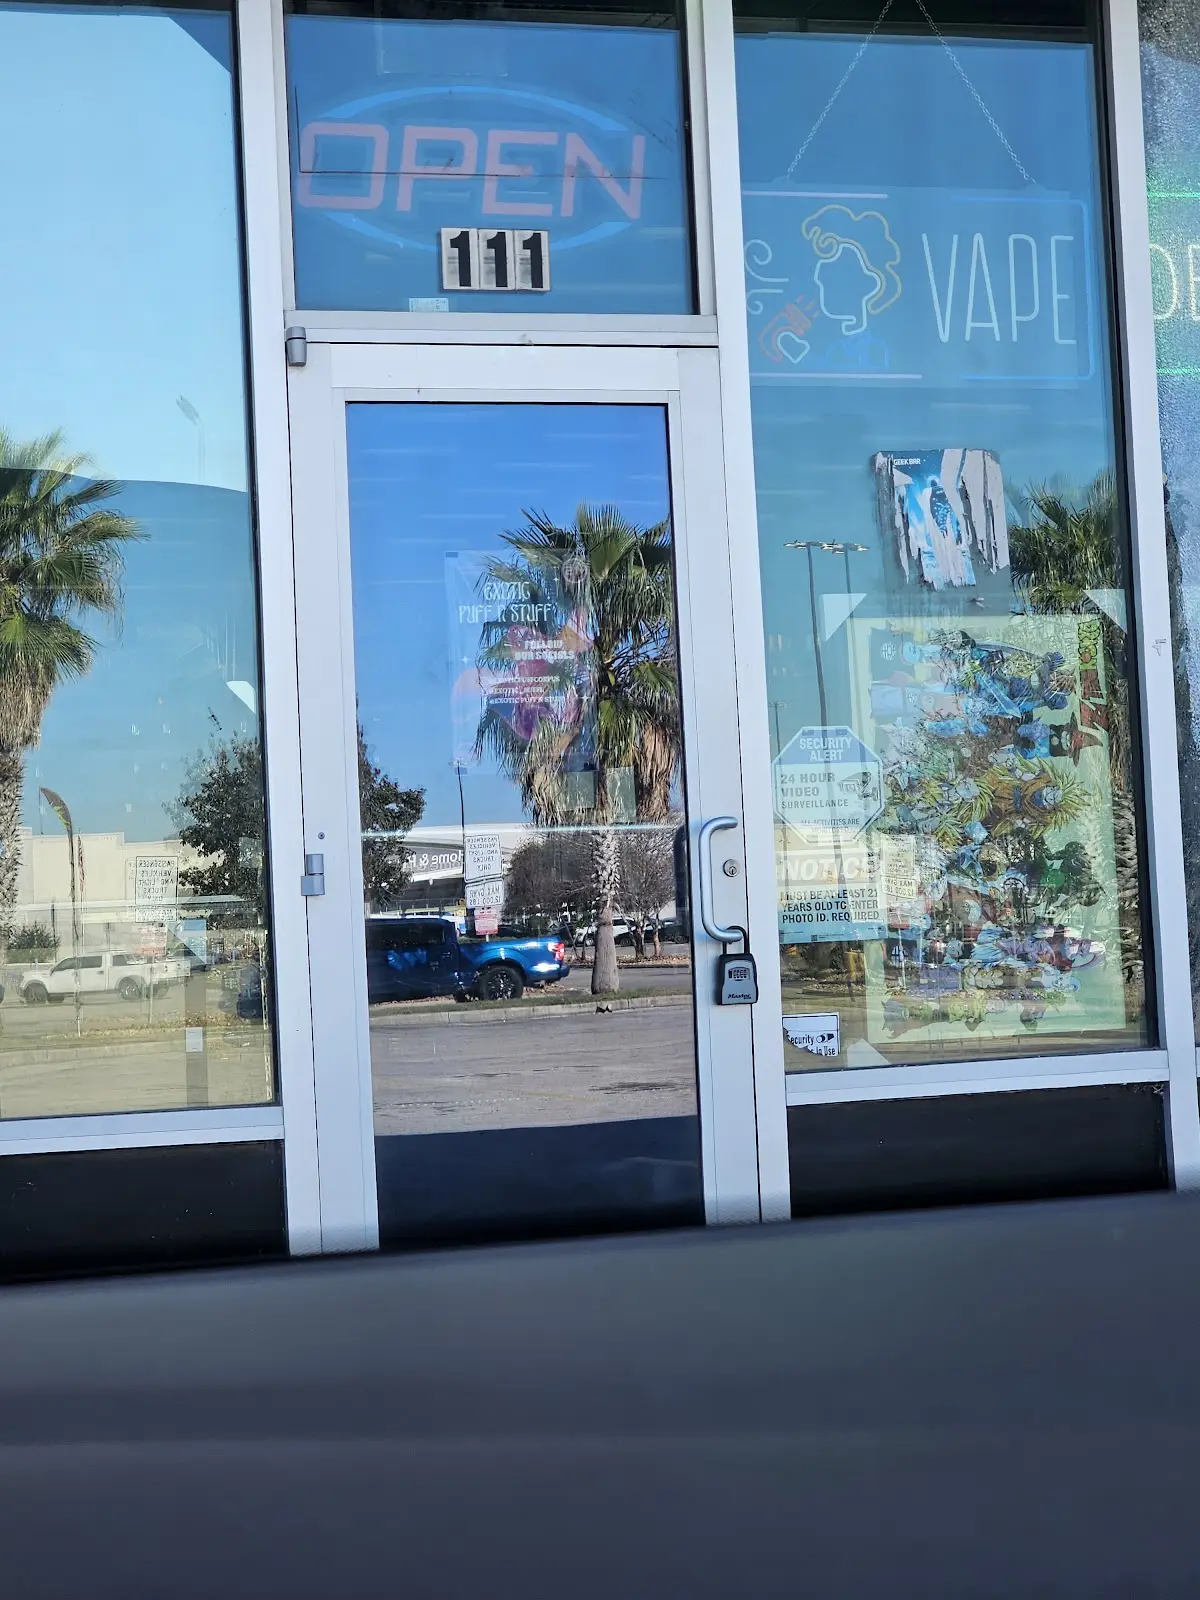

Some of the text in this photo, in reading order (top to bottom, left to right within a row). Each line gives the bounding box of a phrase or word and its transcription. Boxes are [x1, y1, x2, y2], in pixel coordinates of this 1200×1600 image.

[297, 121, 645, 219] OPEN
[449, 229, 544, 289] 111
[921, 232, 1077, 345] VAPE
[459, 605, 493, 624] PUFF
[510, 602, 553, 623] STUFF
[799, 736, 852, 750] SECURITY
[809, 749, 844, 761] ALERT
[780, 772, 836, 785] 24 HOUR
[780, 786, 820, 797] VIDEO
[781, 799, 849, 809] SURVEILLANCE
[780, 891, 808, 901] MUST
[811, 890, 823, 900] BE
[837, 888, 865, 899] LEAST
[868, 888, 878, 898] 21
[782, 902, 812, 913] YEARS
[814, 901, 832, 912] OLD
[850, 900, 879, 910] ENTER
[782, 913, 814, 924] PHOTO
[816, 912, 829, 922] ID.
[787, 1033, 814, 1046] Security
[824, 1046, 836, 1056] Use
